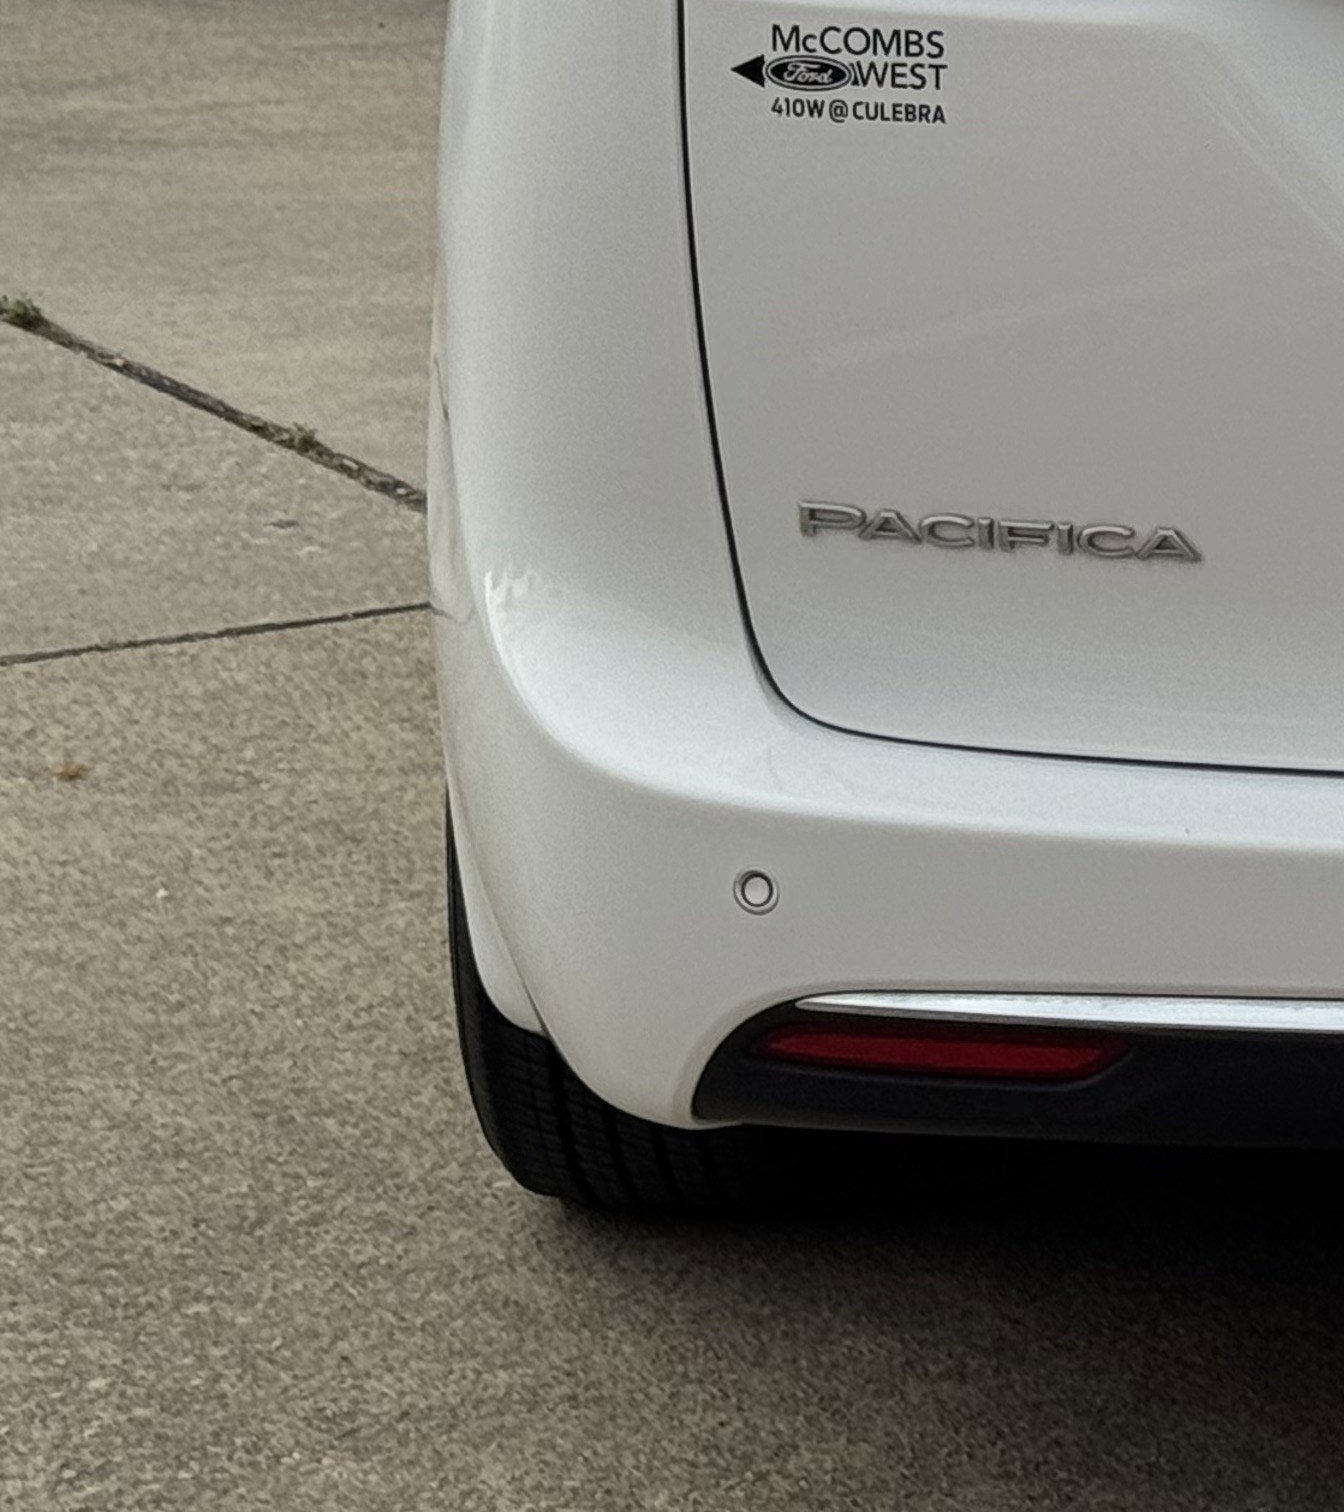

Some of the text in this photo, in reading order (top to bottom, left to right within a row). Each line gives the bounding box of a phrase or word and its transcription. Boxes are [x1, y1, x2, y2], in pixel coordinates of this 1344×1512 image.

[771, 23, 944, 59] McCOMBS
[782, 60, 948, 90] Ford WEST
[852, 100, 946, 125] CULEBRA
[798, 499, 1203, 563] PACIFICA
